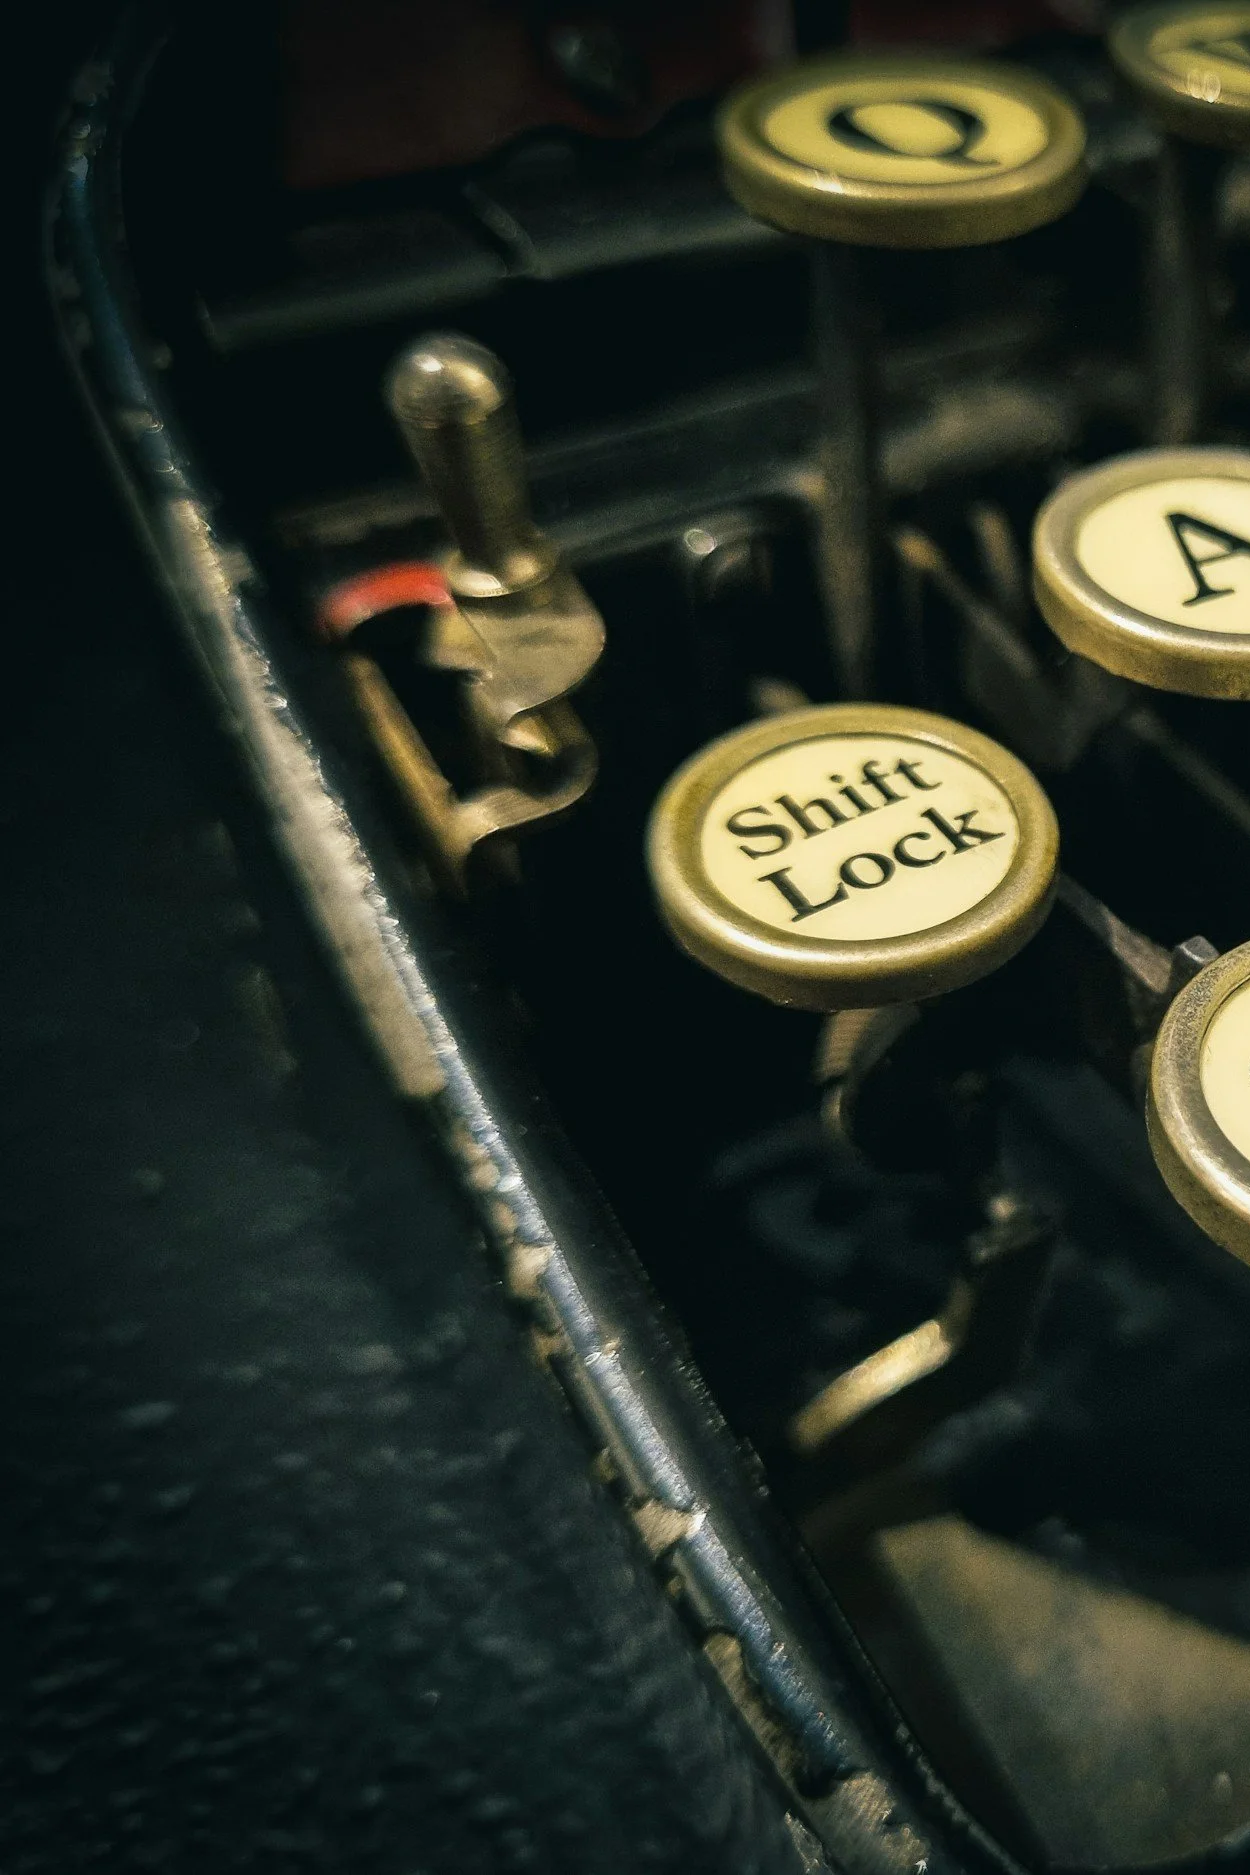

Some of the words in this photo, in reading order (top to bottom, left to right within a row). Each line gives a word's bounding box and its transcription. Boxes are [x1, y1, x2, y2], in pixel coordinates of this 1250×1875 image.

[826, 97, 1003, 168] Q
[726, 757, 943, 861] Shift
[757, 806, 1006, 923] Lock
